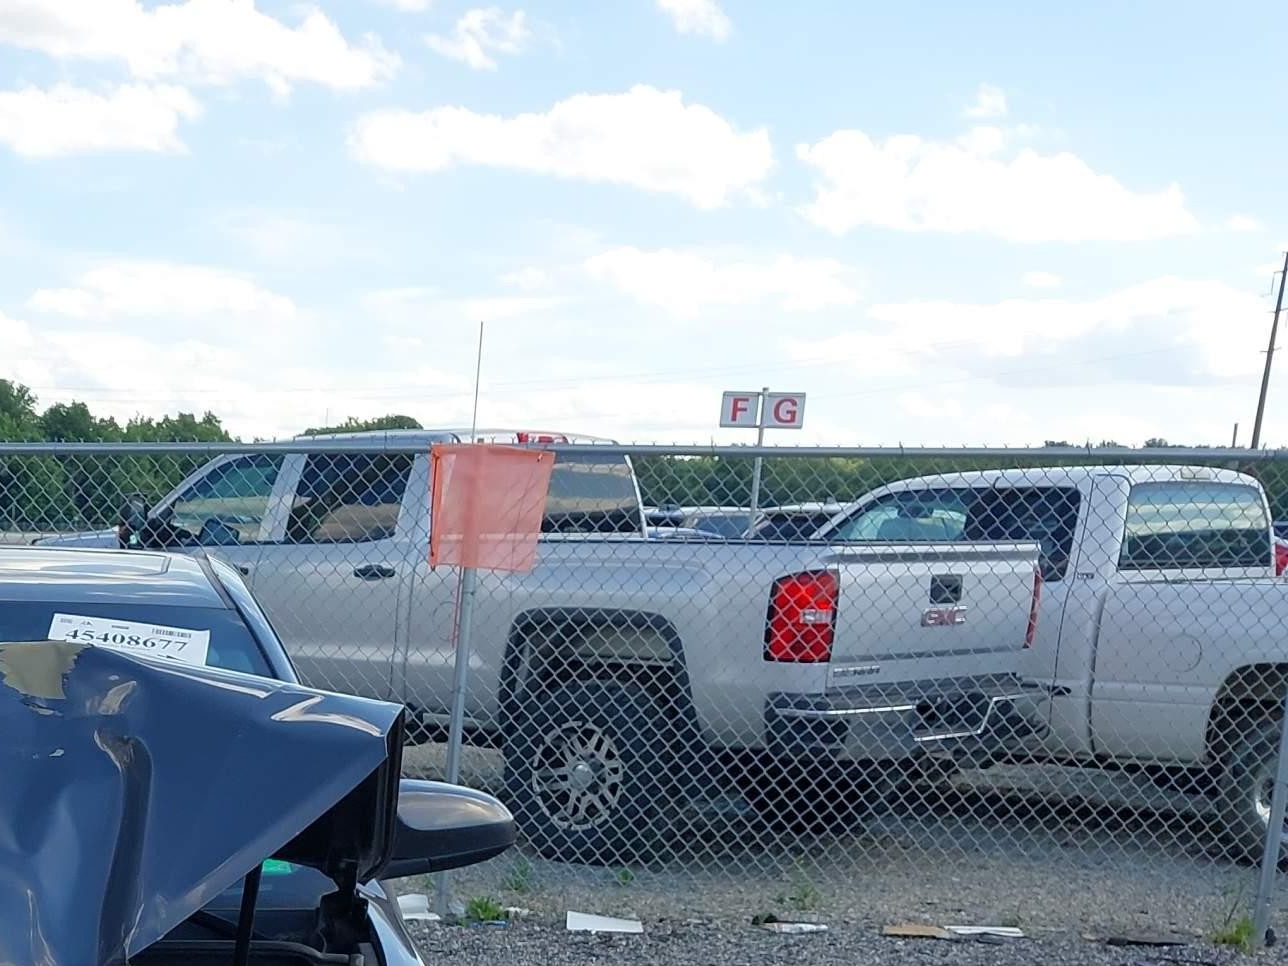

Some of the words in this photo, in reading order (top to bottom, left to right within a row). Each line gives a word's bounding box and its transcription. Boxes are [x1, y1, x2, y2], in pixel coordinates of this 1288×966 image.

[731, 397, 749, 422] F
[773, 398, 798, 424] G
[65, 628, 189, 652] 45408677
